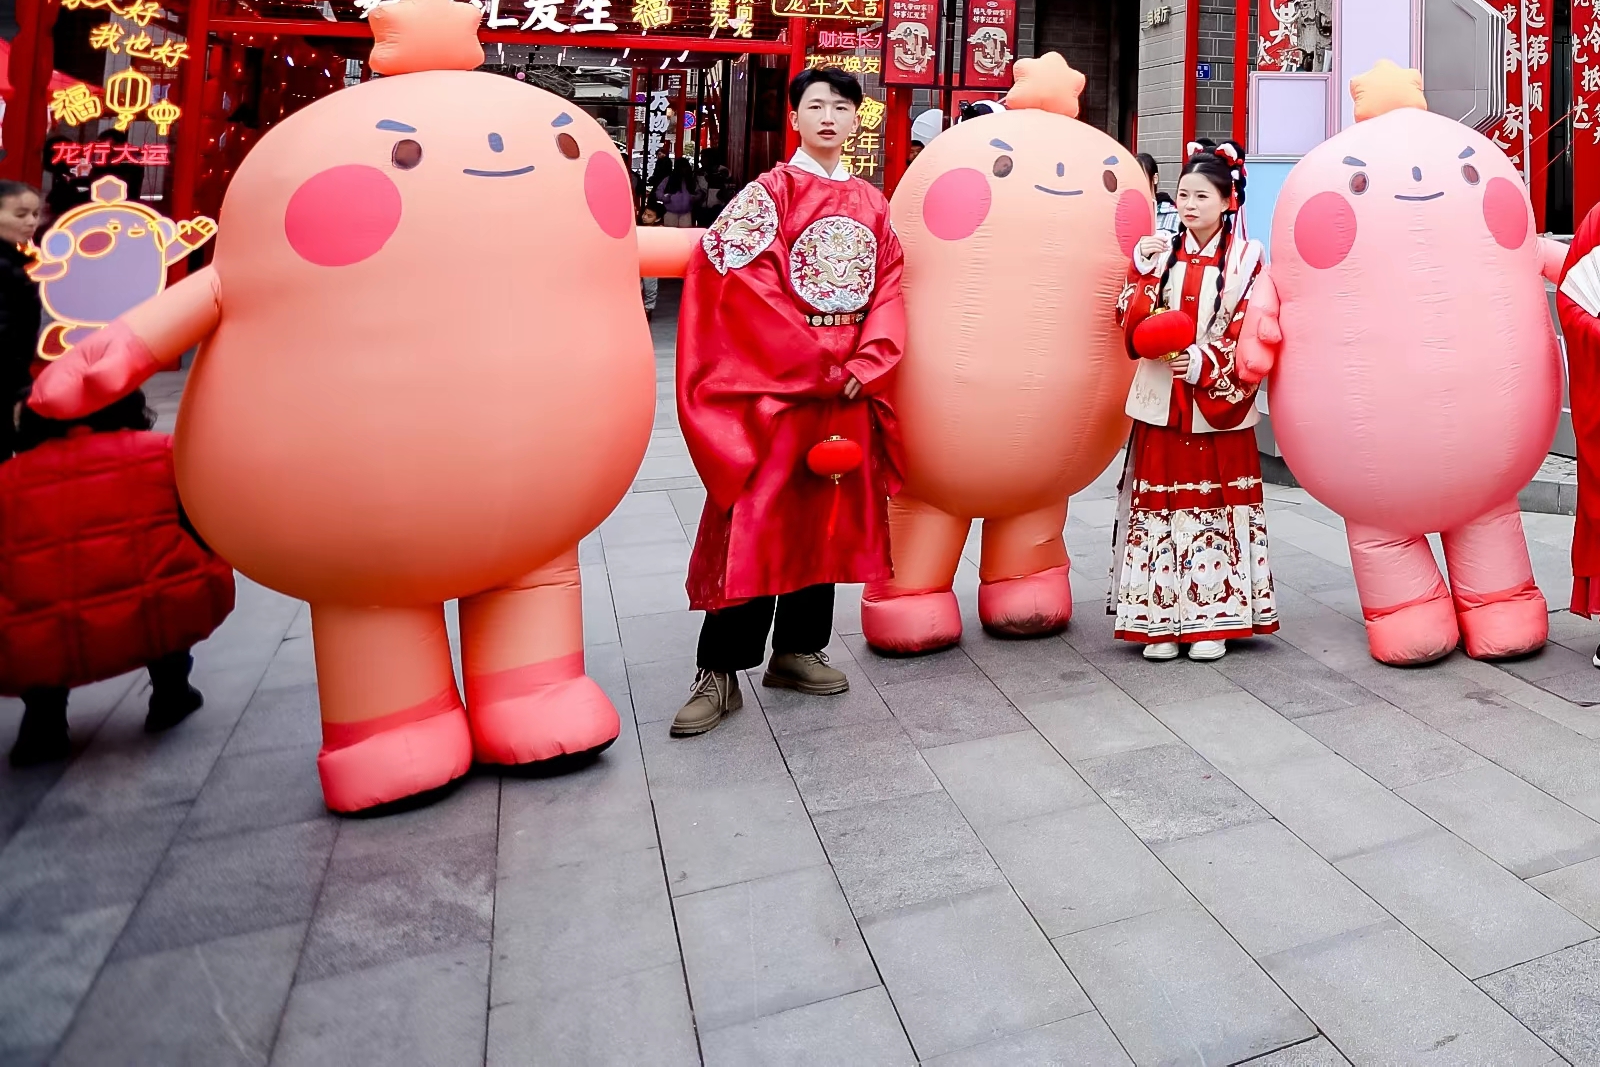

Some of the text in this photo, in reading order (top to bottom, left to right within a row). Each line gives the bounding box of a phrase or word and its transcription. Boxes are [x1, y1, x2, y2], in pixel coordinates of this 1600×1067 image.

[90, 25, 191, 69] 我也好
[50, 82, 102, 128] 福
[52, 140, 171, 166] 龙行大运
